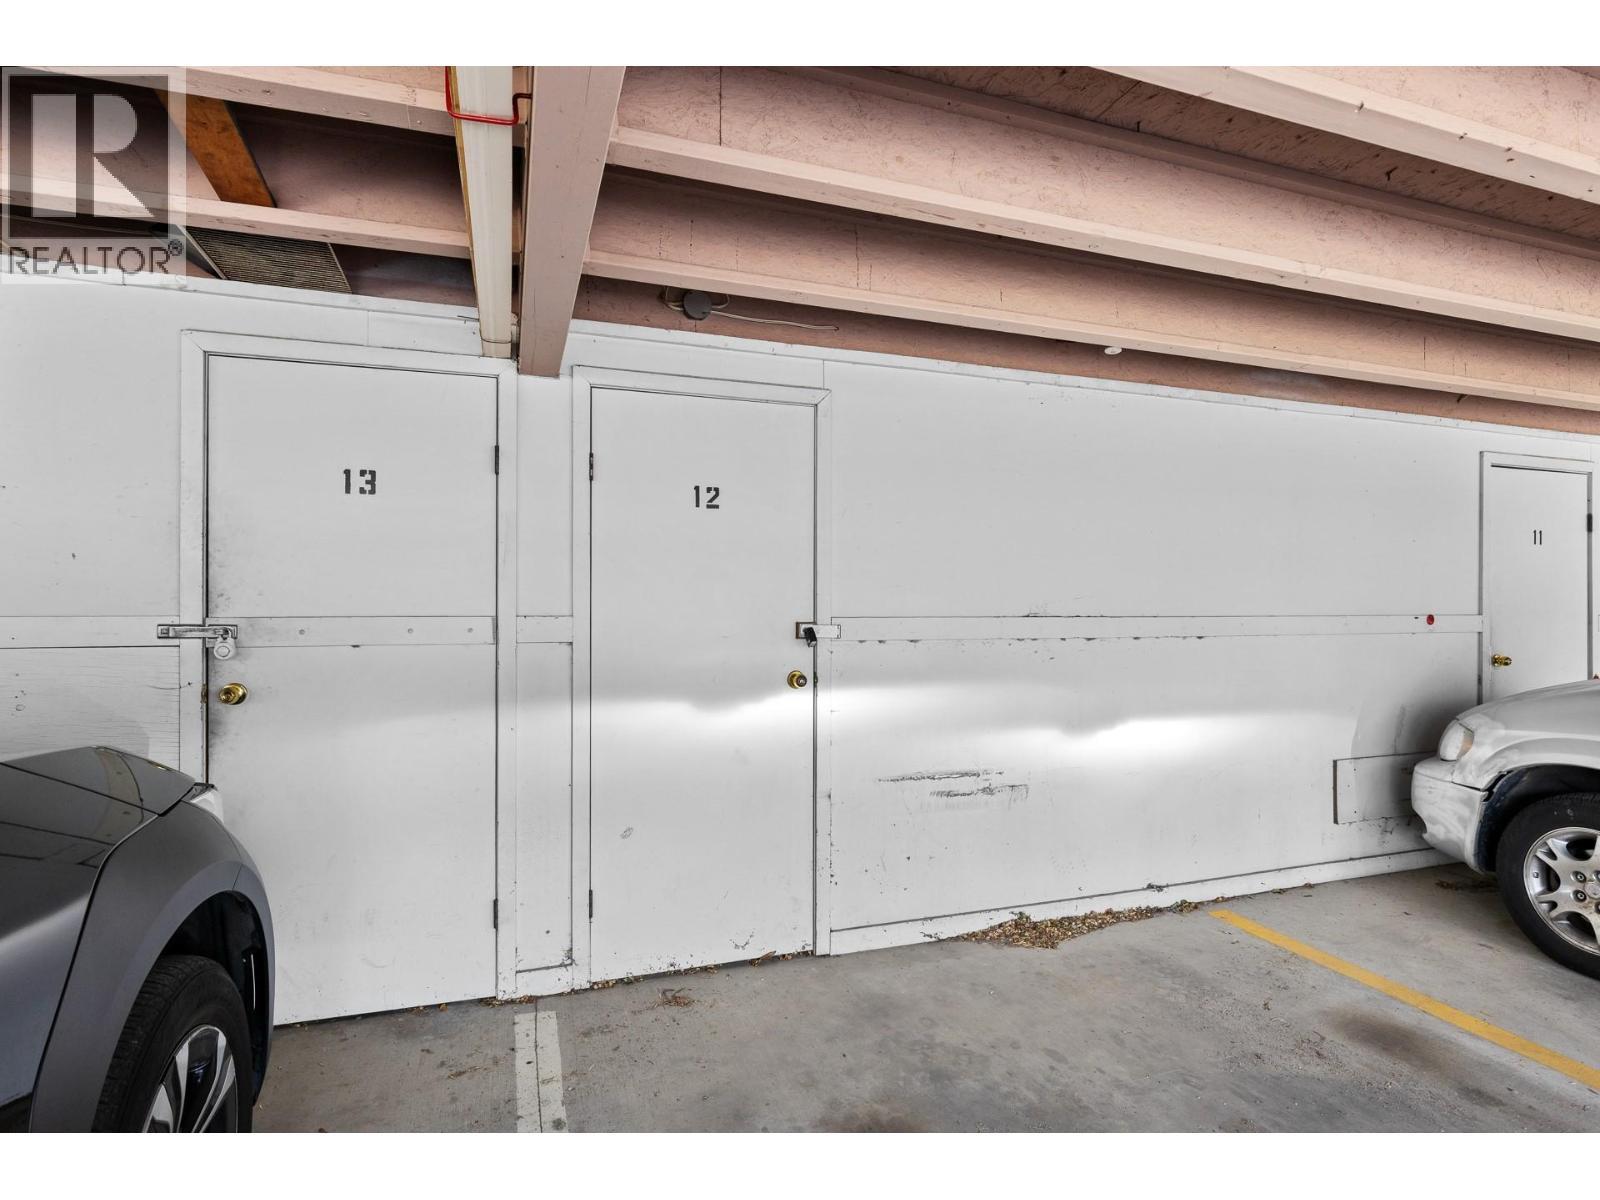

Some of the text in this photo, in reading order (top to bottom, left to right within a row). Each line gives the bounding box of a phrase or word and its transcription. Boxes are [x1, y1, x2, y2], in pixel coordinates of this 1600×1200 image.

[343, 469, 377, 495] 13
[694, 485, 720, 509] 12
[1533, 529, 1543, 545] 11
